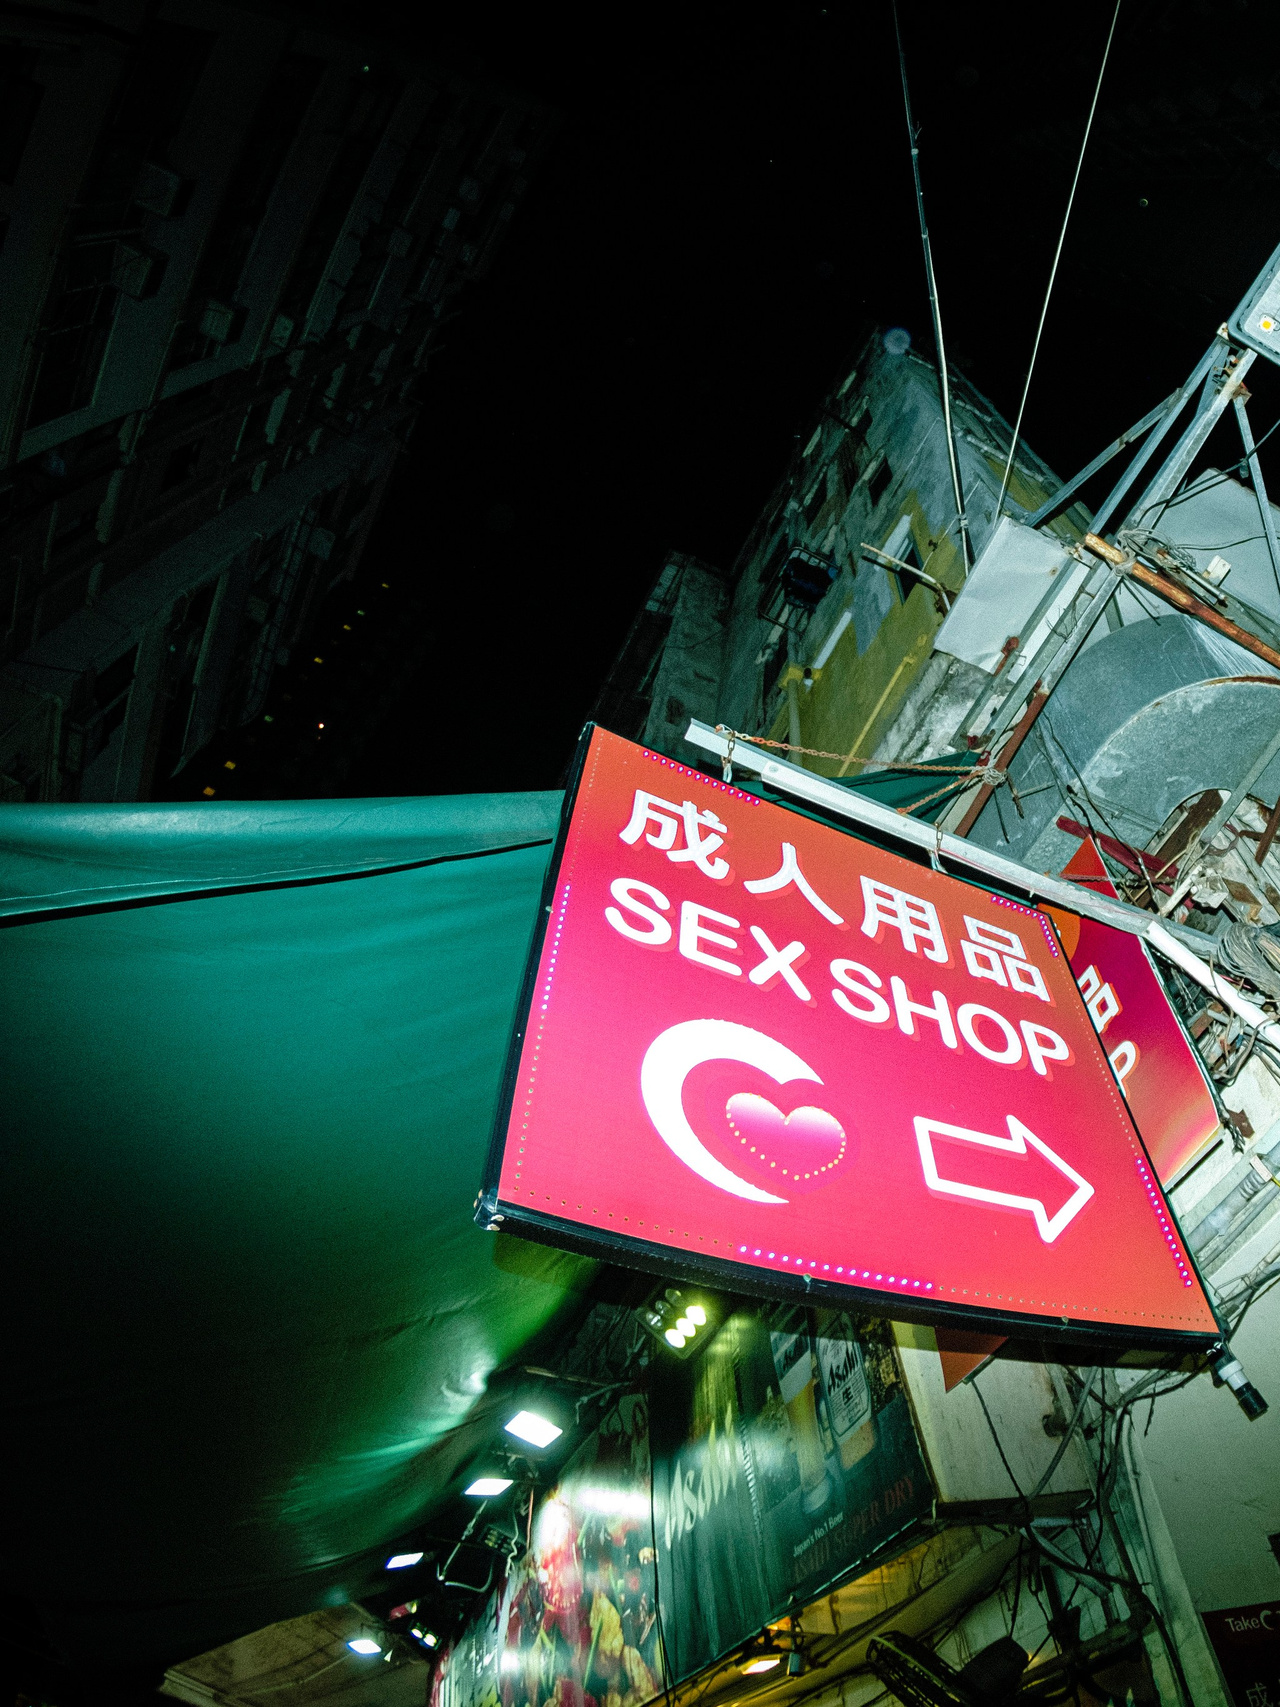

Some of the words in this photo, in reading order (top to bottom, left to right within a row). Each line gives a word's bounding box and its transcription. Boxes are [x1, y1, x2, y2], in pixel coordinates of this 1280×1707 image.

[604, 877, 813, 1002] SEX
[829, 957, 1071, 1077] SHOP
[619, 789, 1052, 1003] 成人用品
[1225, 1616, 1260, 1632] Take
